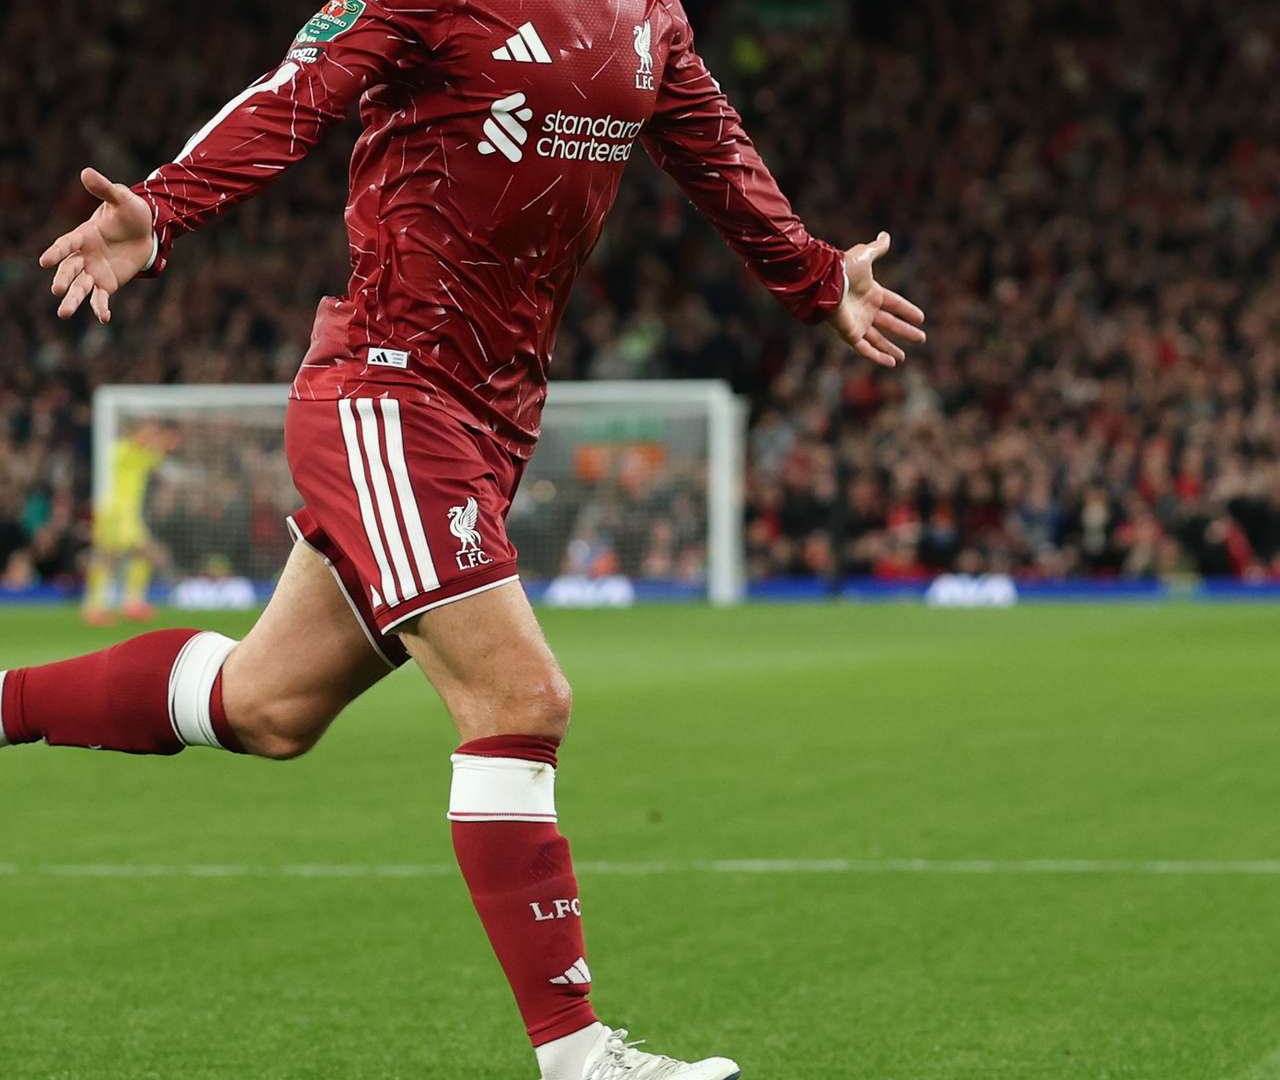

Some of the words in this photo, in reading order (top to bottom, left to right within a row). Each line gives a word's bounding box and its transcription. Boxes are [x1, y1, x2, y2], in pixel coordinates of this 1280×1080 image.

[309, 18, 330, 30] Cup
[541, 109, 645, 139] standard
[536, 134, 635, 162] chartered
[529, 897, 582, 921] LFC
